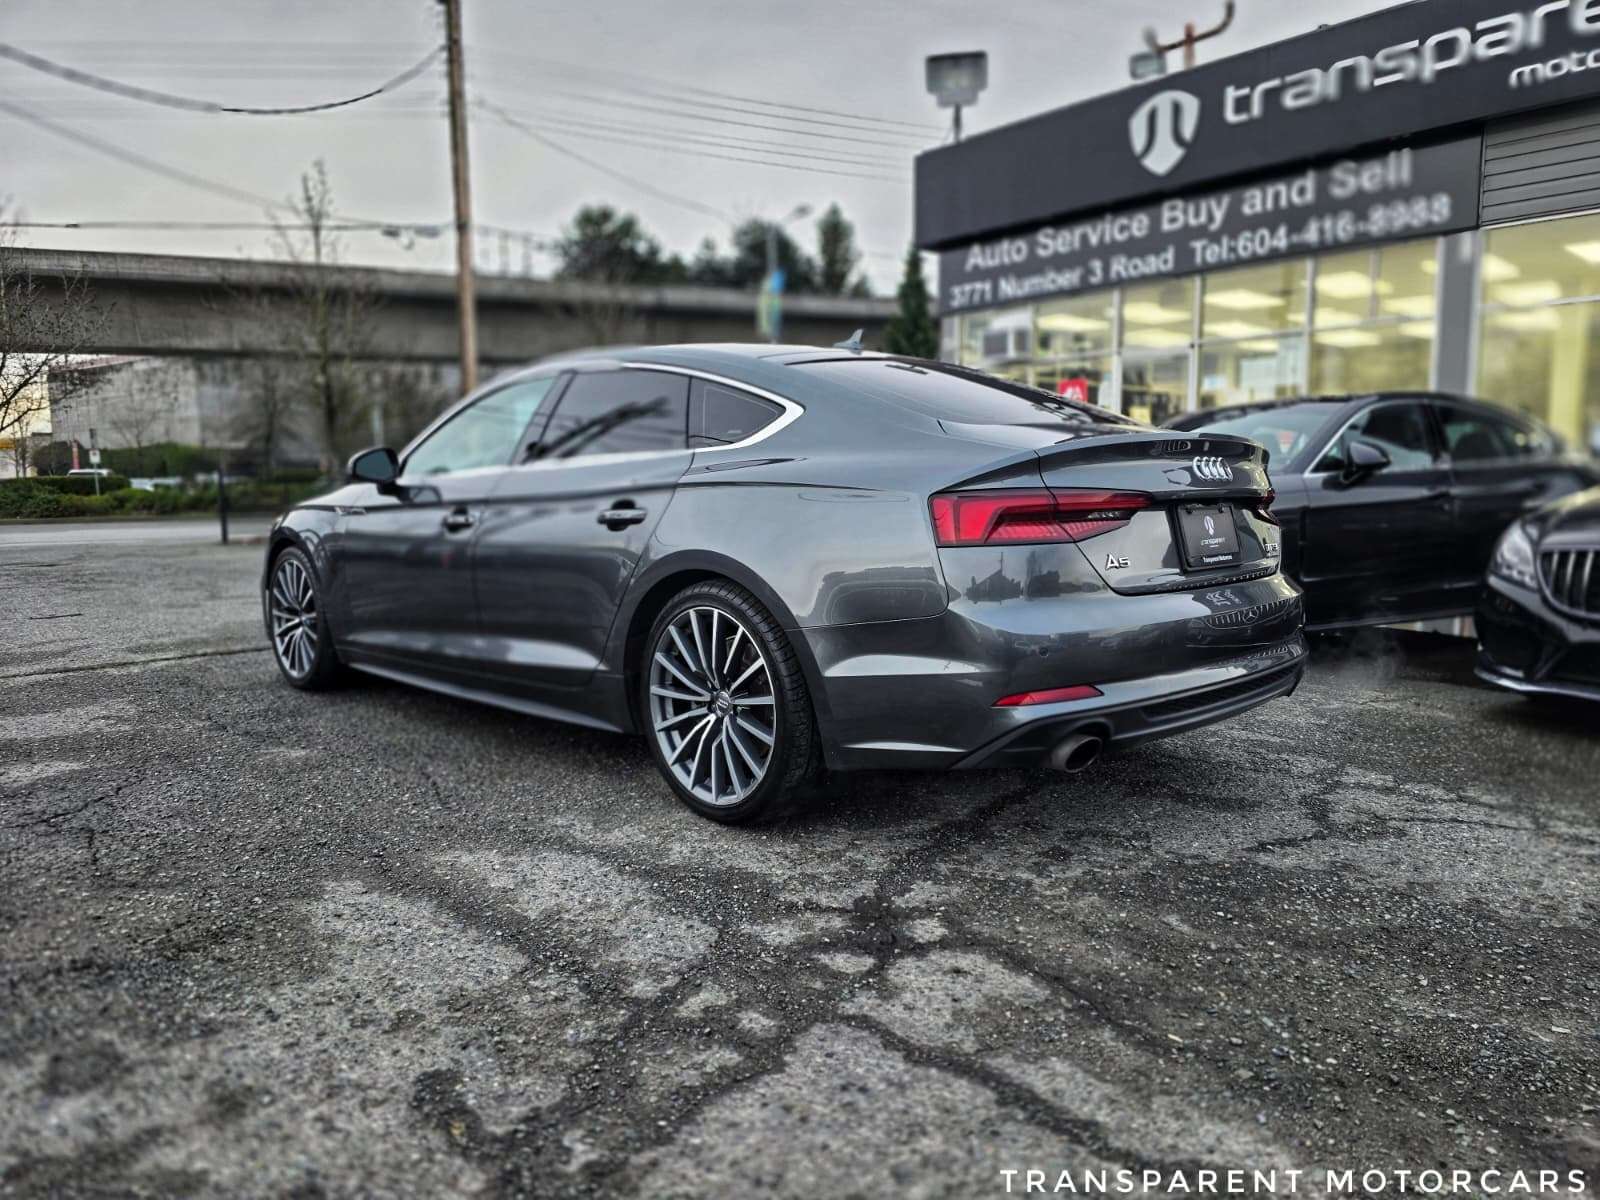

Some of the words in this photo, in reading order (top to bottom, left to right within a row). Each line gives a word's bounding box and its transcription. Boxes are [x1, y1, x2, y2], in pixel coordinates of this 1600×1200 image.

[964, 239, 1028, 271] Auto
[1035, 212, 1149, 258] Service
[1160, 194, 1231, 231] Buy
[1241, 169, 1316, 216] and
[1328, 147, 1412, 199] Sell
[950, 279, 992, 307] 3771
[998, 265, 1082, 299] Number
[1088, 259, 1104, 285] 3
[1110, 245, 1176, 281] Road
[1105, 553, 1131, 571] A5
